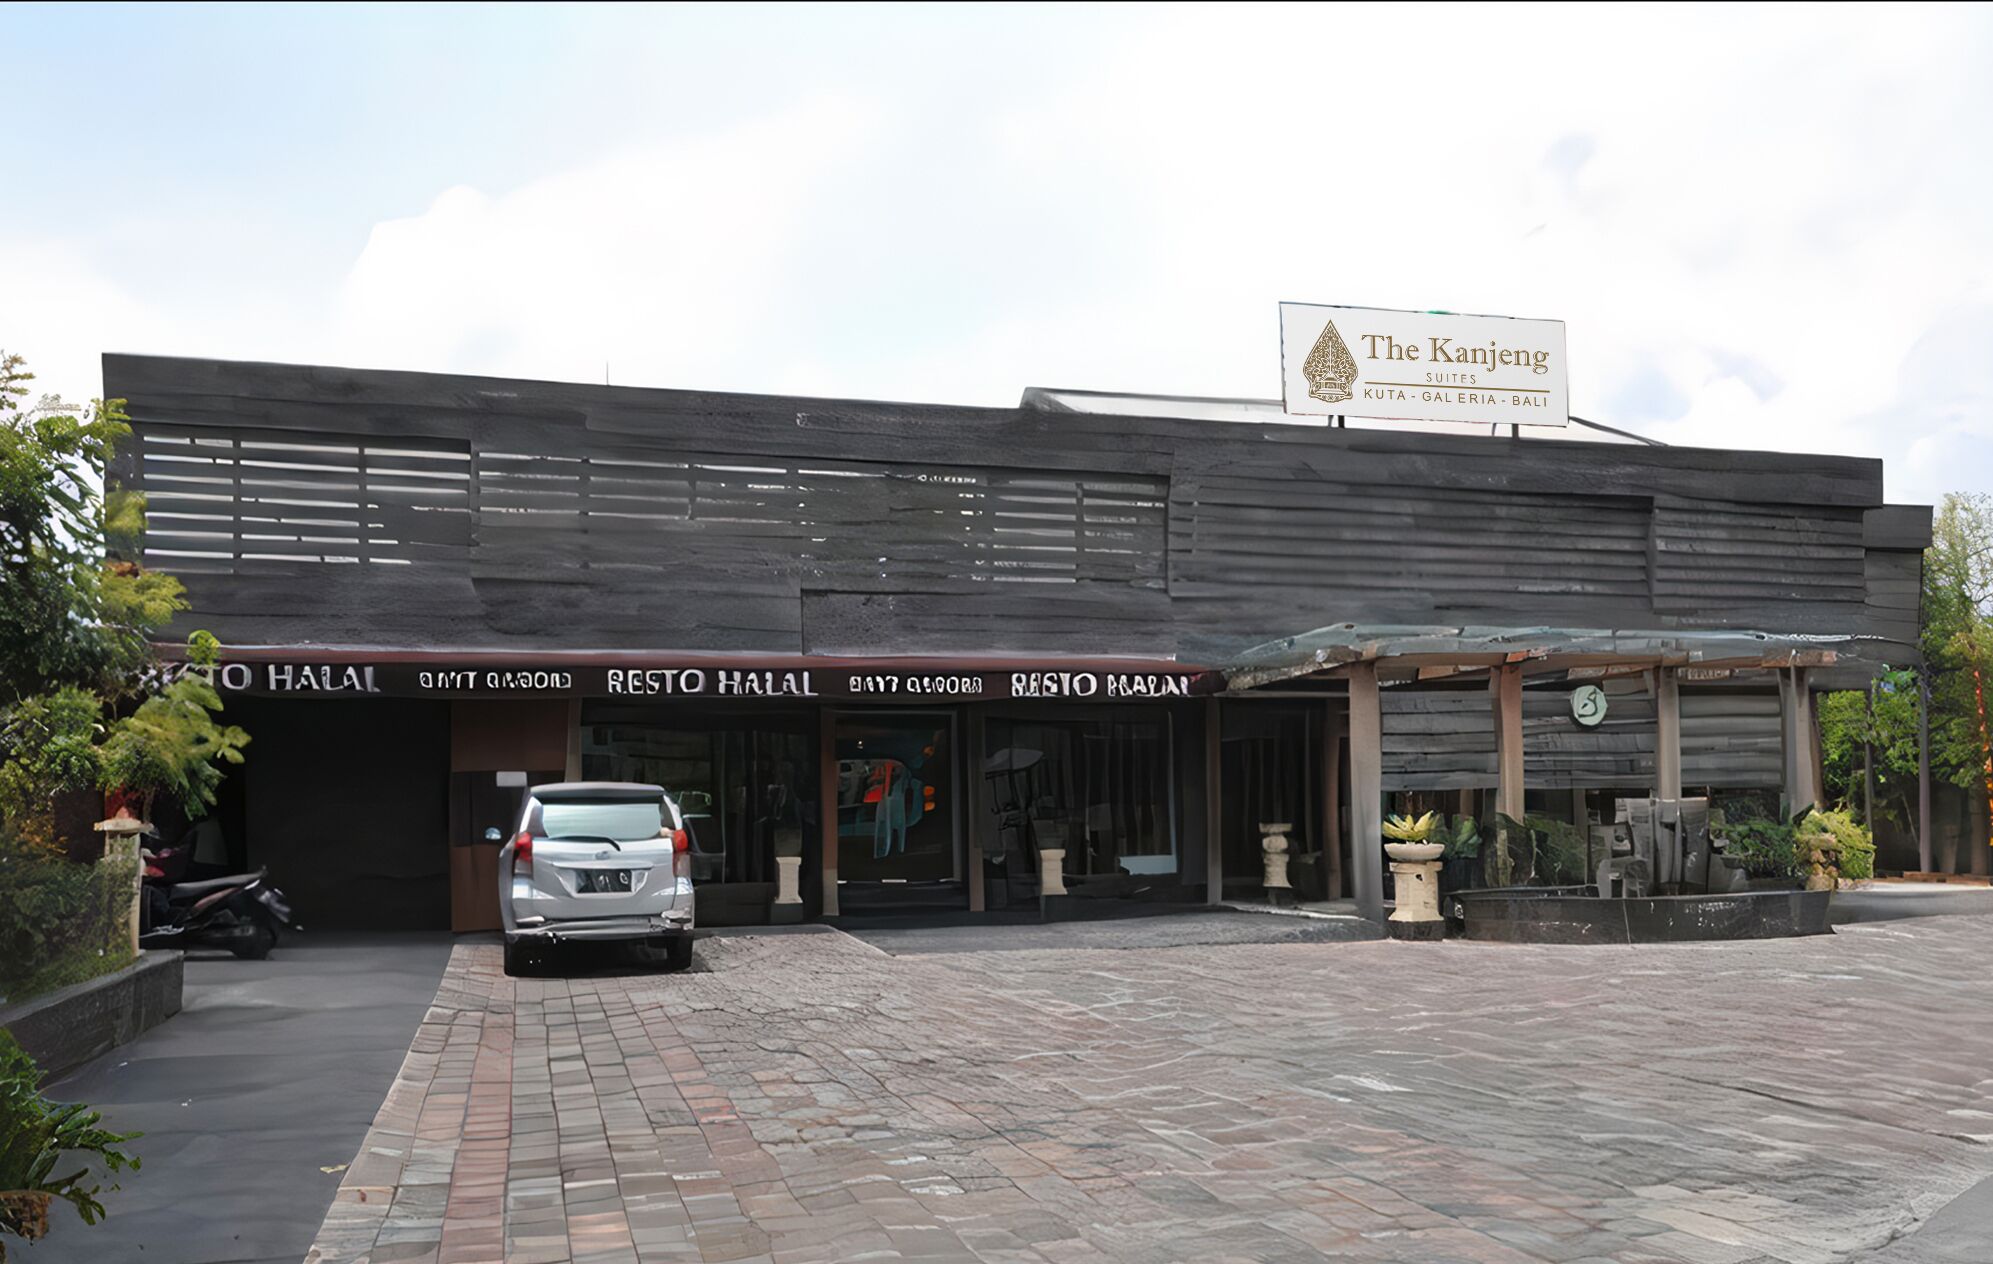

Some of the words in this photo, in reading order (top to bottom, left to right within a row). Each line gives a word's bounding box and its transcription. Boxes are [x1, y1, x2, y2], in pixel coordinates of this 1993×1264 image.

[1361, 334, 1420, 362] The
[1427, 336, 1550, 376] Kanjeng
[1426, 372, 1477, 385] SUITES
[1364, 388, 1406, 401] KUTA
[1421, 390, 1497, 405] GALERIA
[1512, 395, 1547, 408] BALI
[267, 664, 381, 693] HALAL
[607, 669, 705, 695] RESTO
[718, 670, 819, 697] HALAL
